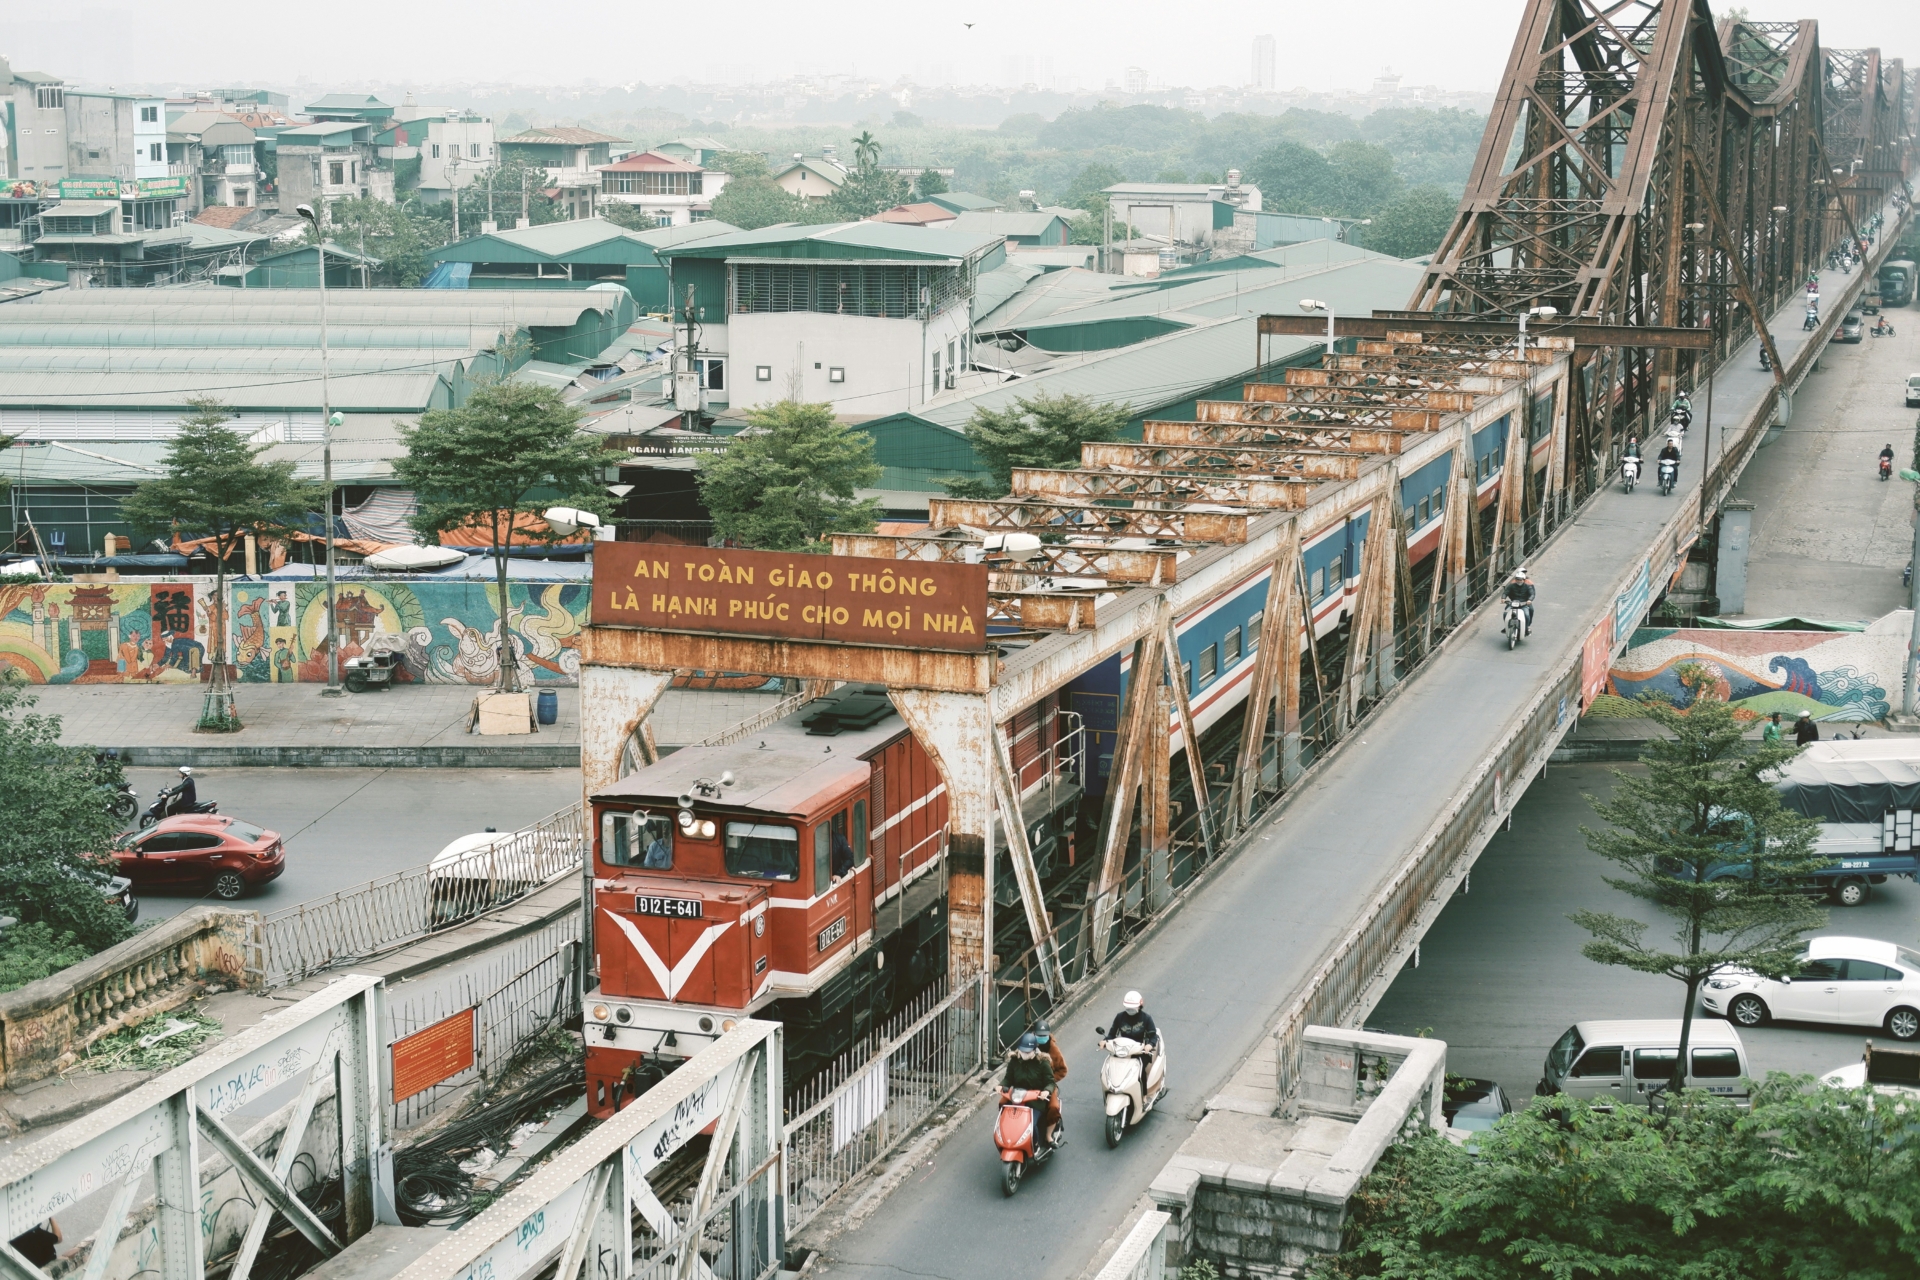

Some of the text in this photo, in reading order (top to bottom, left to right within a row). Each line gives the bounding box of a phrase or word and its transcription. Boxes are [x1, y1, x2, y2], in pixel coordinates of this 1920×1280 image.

[634, 560, 670, 580] AN
[685, 558, 754, 585] TOÀN
[848, 568, 938, 596] THÔNG
[610, 585, 640, 611] LÀ
[651, 593, 717, 619] HẠNH
[729, 593, 790, 621] PHÚC
[802, 605, 850, 626] CHO
[923, 605, 976, 635] NHÀ
